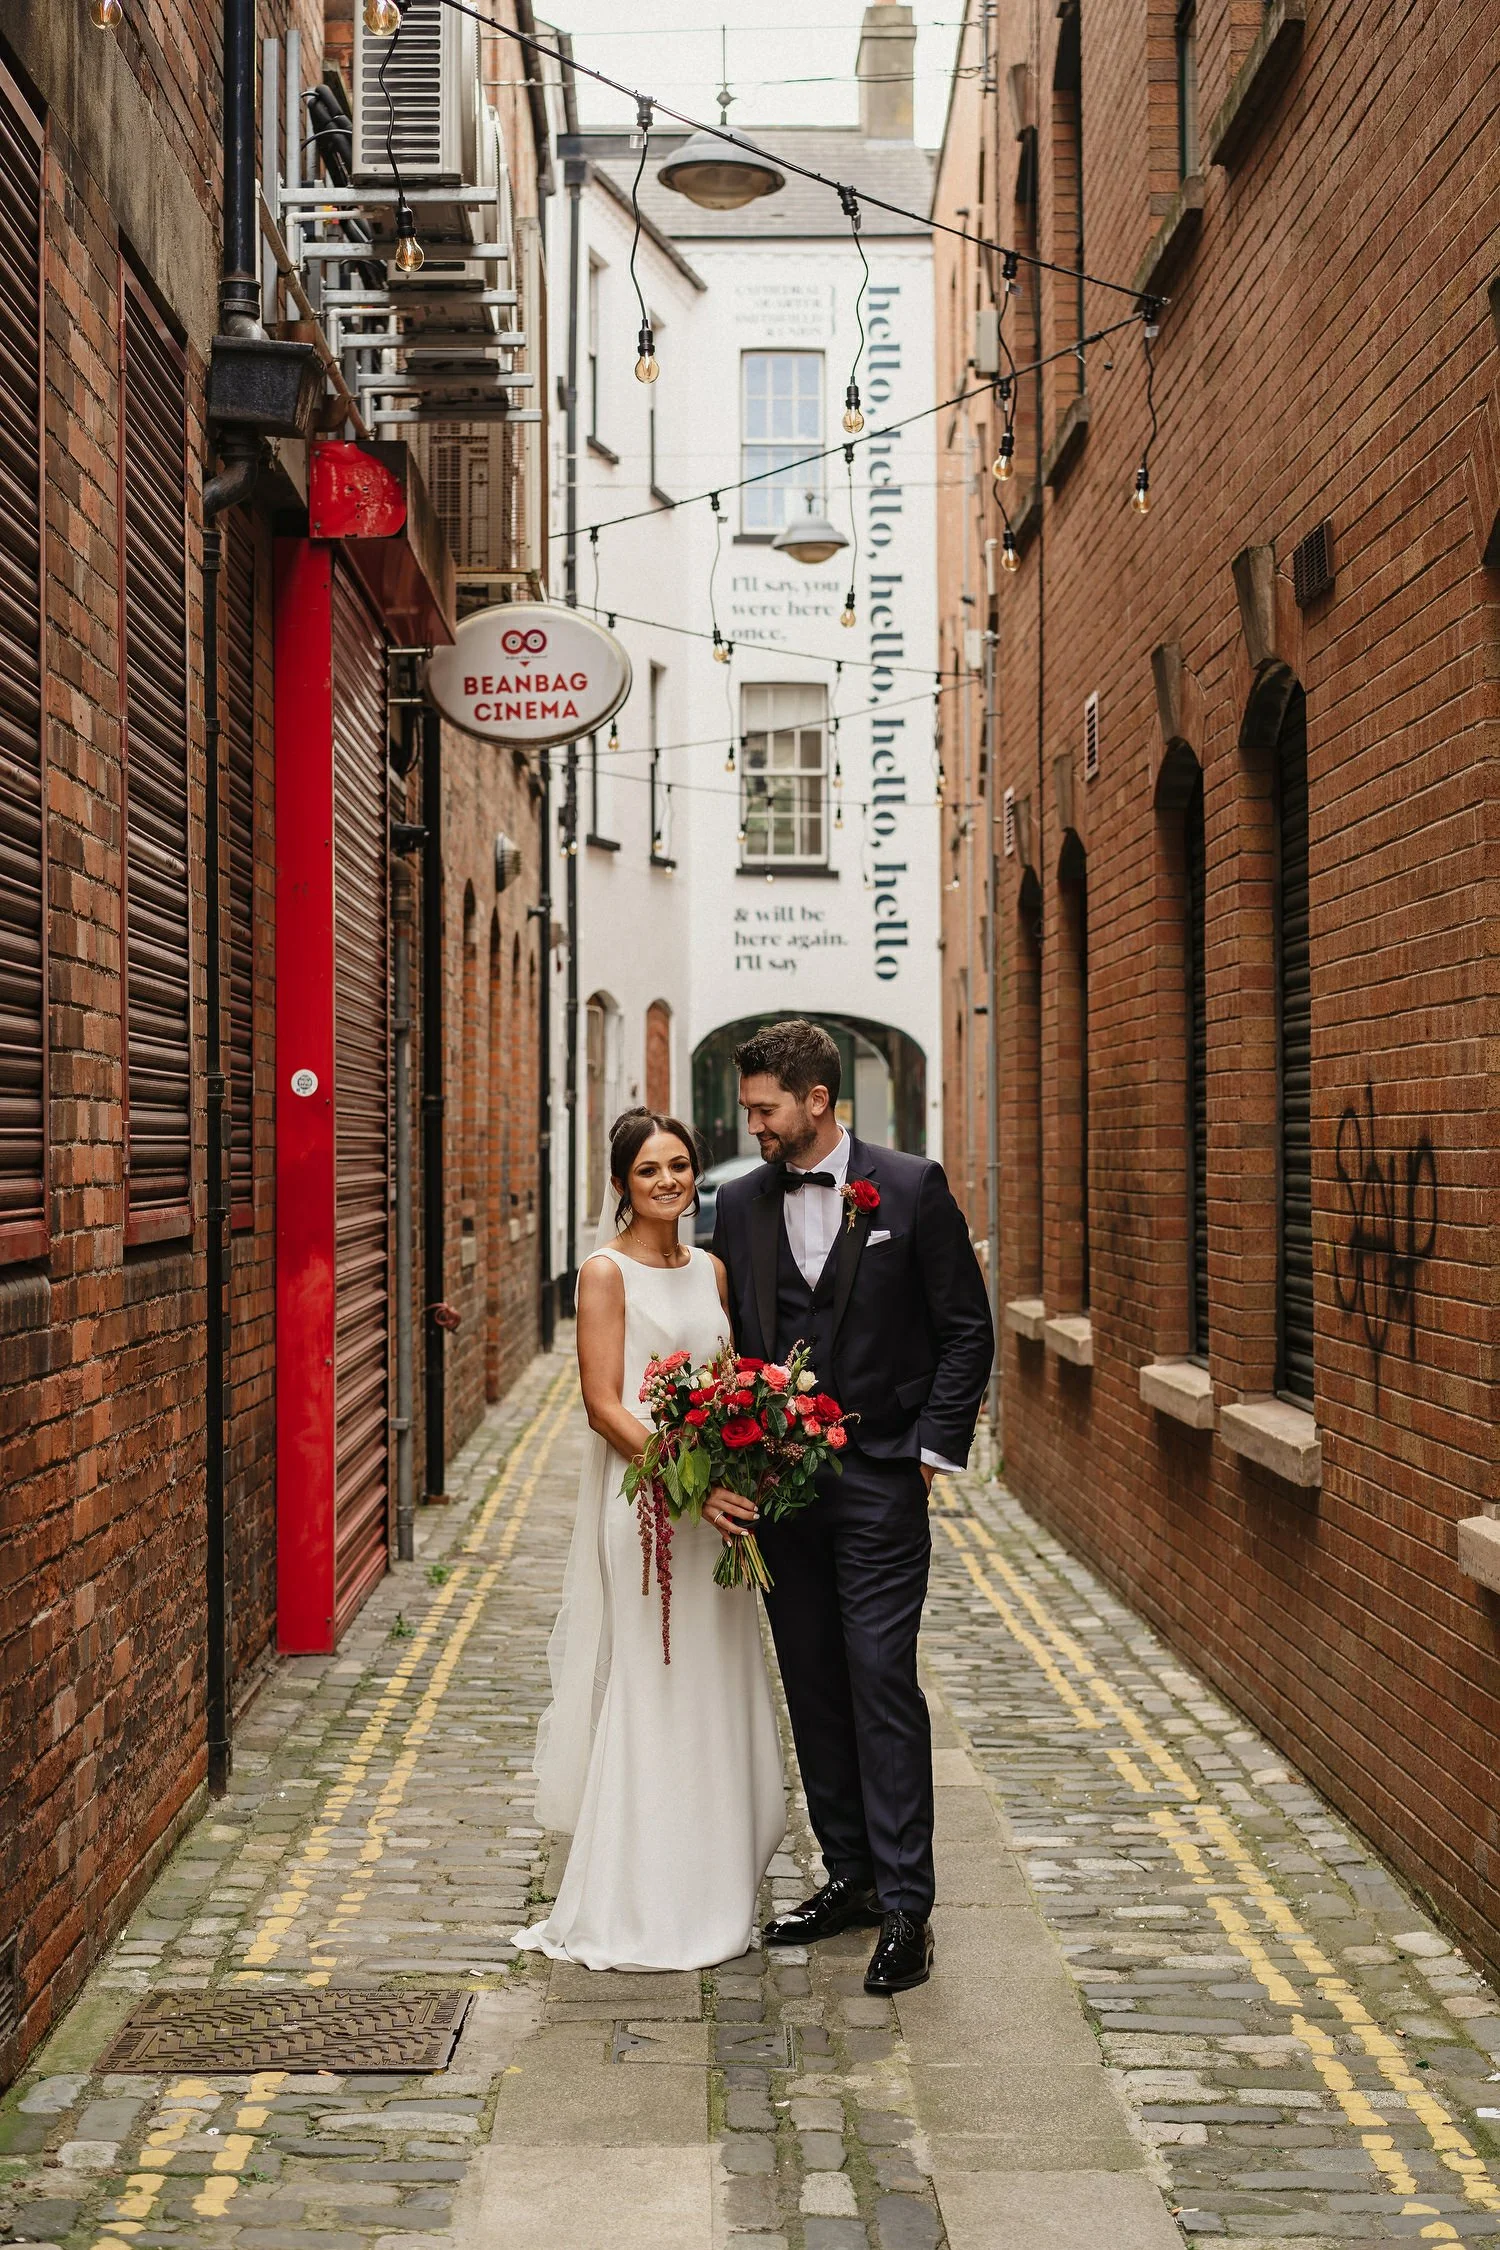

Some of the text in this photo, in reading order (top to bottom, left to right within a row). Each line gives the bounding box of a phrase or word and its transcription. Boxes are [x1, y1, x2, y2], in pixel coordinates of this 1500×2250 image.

[804, 582, 840, 598] you
[734, 602, 834, 618] were here
[865, 287, 909, 981] hello, hello, hello, hello, hello
[464, 672, 587, 695] BEANBAG
[474, 700, 579, 722] CINEMA
[734, 906, 825, 922] & will be
[734, 930, 848, 949] here again.
[769, 958, 799, 975] say
